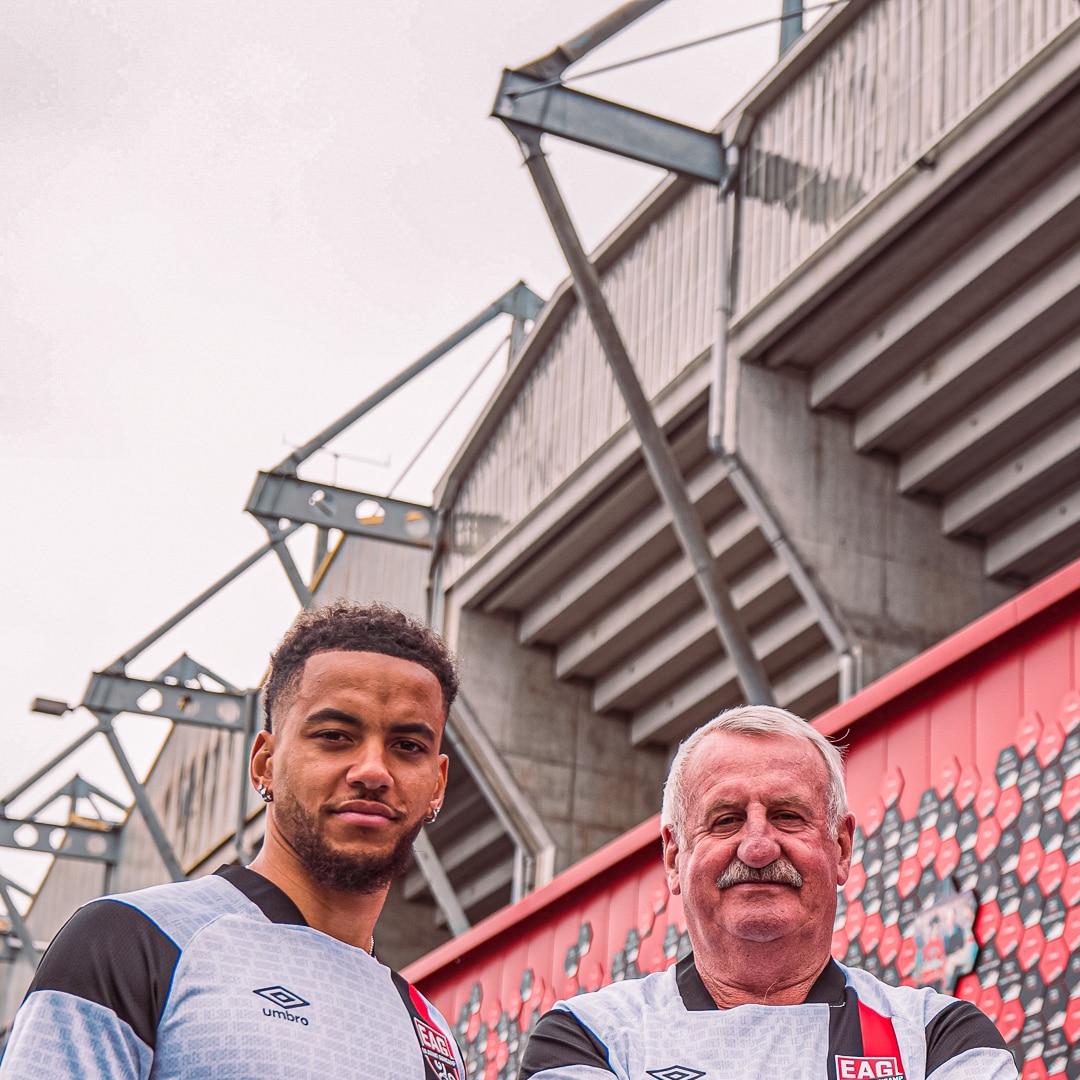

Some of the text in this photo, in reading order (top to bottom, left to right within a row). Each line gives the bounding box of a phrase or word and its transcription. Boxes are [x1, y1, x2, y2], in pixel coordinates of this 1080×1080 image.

[262, 1007, 309, 1026] umbro
[418, 1023, 449, 1057] EAG
[840, 1060, 893, 1079] EAG
